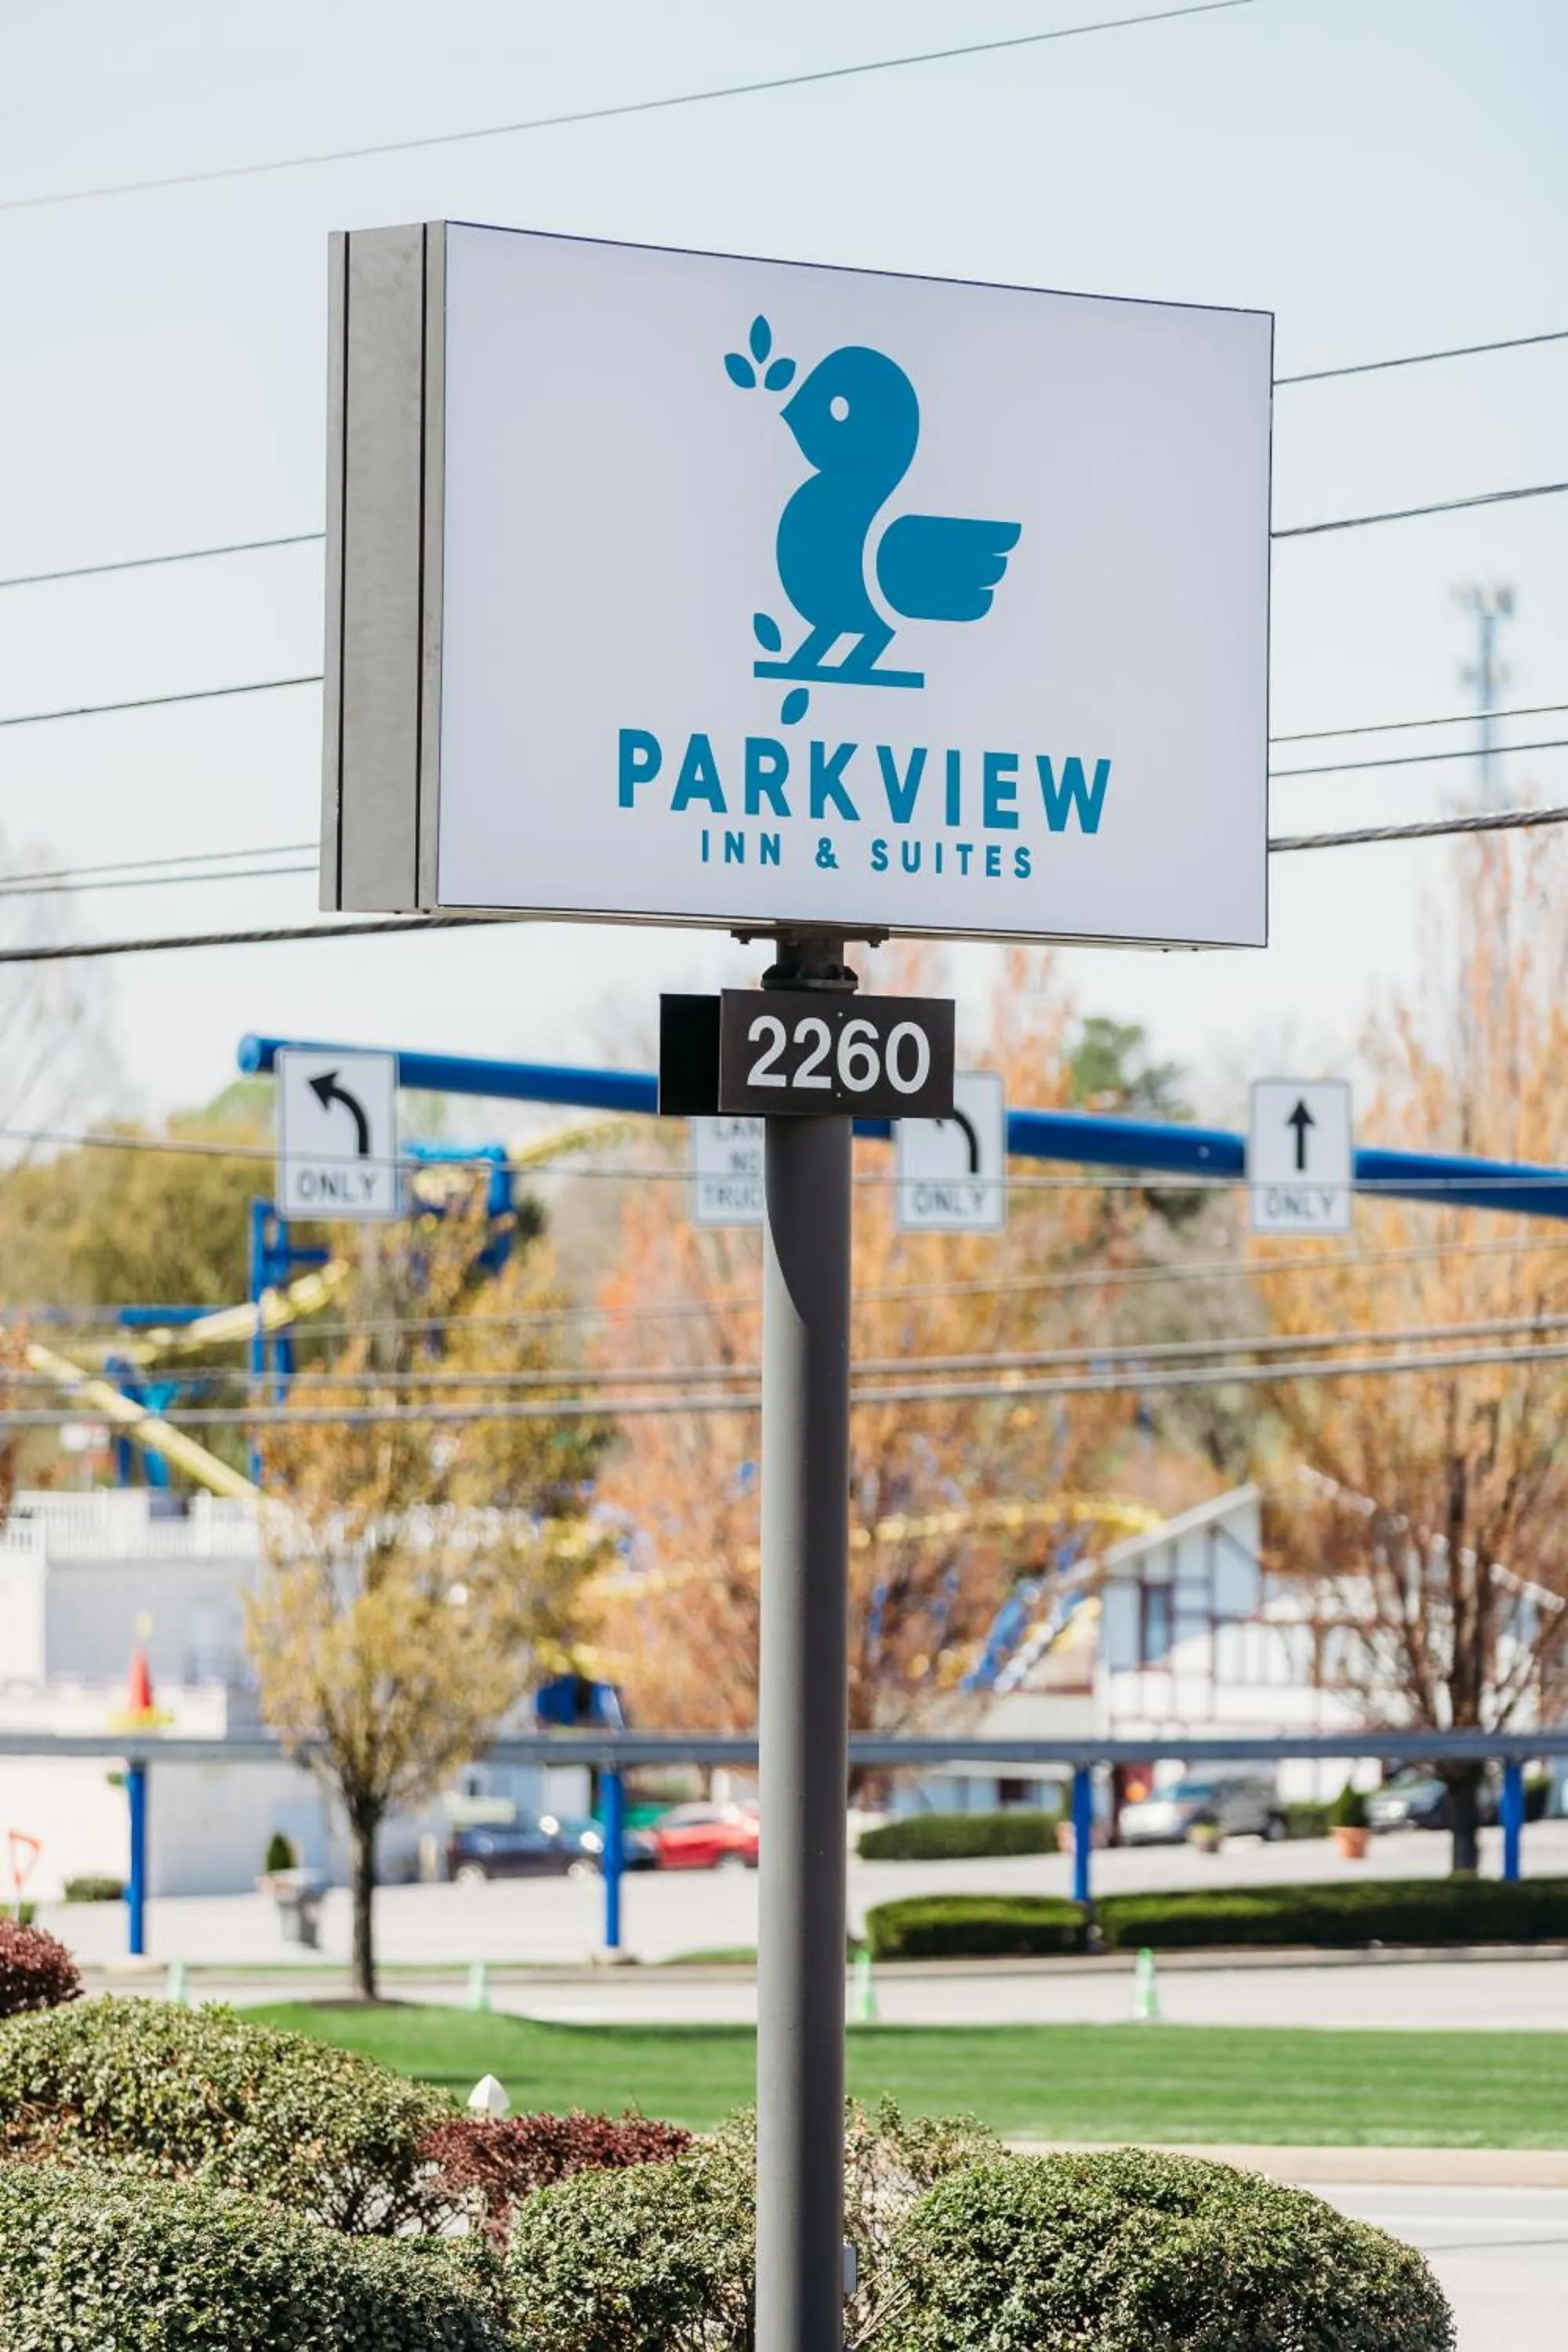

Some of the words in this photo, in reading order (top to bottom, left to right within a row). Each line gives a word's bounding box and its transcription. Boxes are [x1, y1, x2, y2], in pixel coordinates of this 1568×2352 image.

[619, 728, 1111, 834] PARKVIEW
[702, 829, 780, 866] INN
[815, 837, 839, 869] &
[870, 838, 1033, 879] SUITES
[746, 1015, 931, 1094] 2260
[713, 1119, 764, 1141] LAN
[298, 1169, 378, 1203] ONLY
[704, 1184, 765, 1208] TRUC
[912, 1183, 989, 1217] ONLY
[1264, 1186, 1337, 1220] ONLY
